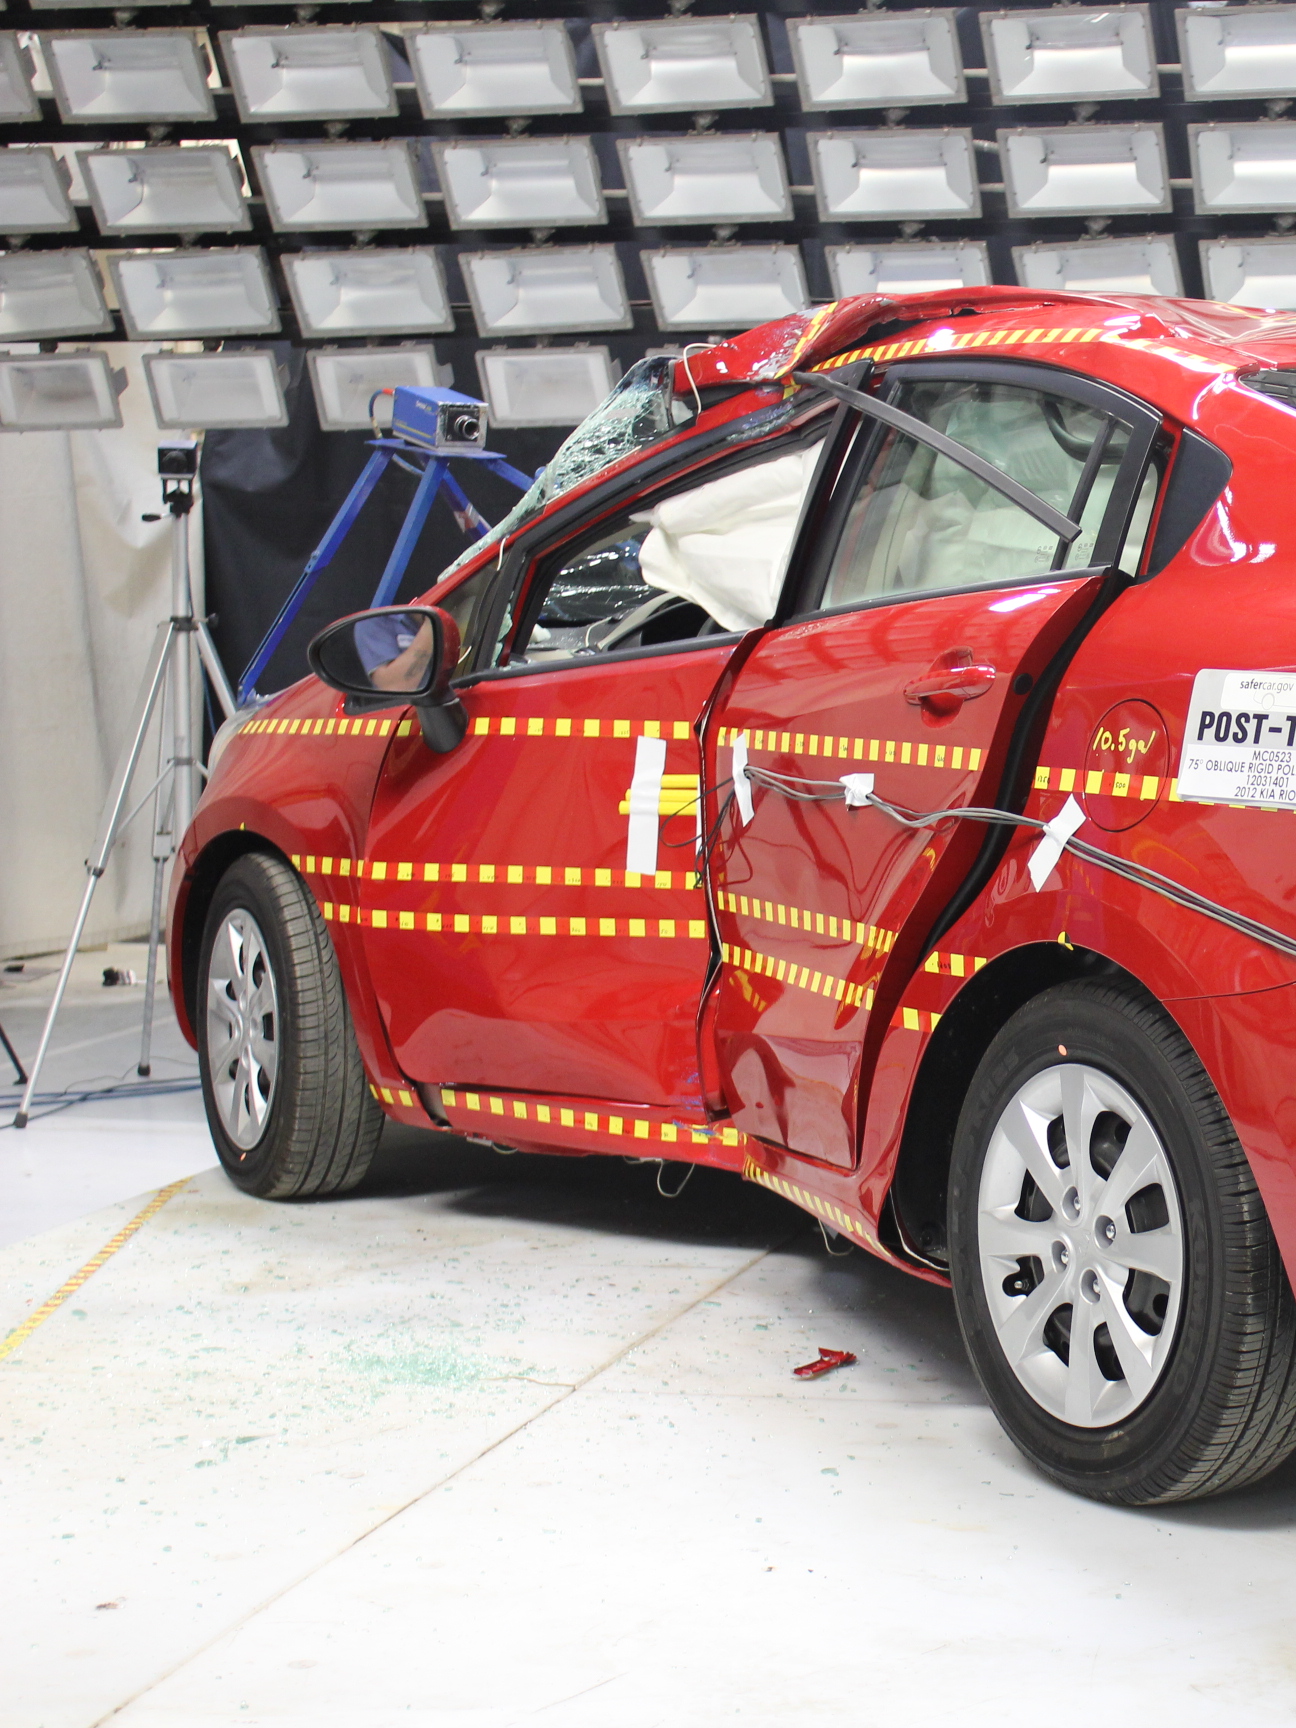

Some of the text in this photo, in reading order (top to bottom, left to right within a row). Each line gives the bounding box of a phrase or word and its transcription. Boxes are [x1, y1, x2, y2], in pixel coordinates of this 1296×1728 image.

[1240, 678, 1295, 694] safercar.gov
[1252, 750, 1292, 763] MC0523
[1188, 758, 1204, 770] 75°
[1205, 759, 1246, 773] OBLIQUE
[1247, 762, 1274, 775] RIGID
[1245, 774, 1289, 789] 12031401
[1234, 786, 1296, 802] 2012 KIA RIO
